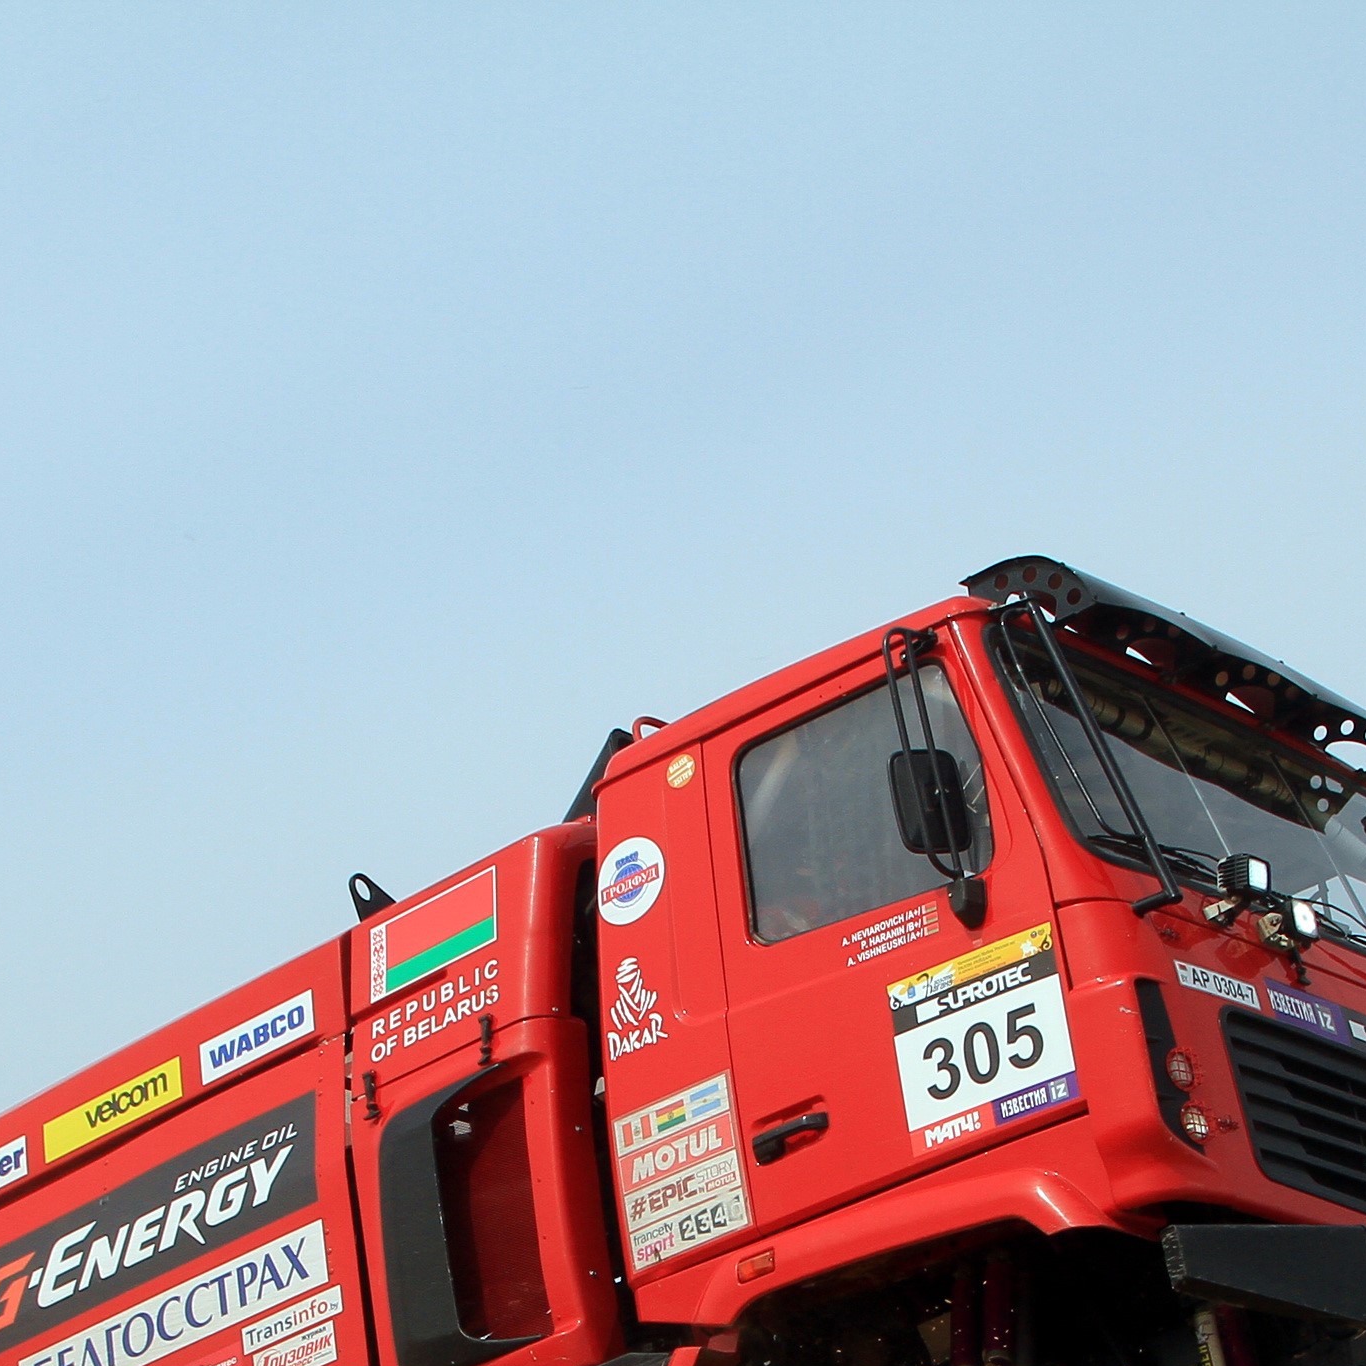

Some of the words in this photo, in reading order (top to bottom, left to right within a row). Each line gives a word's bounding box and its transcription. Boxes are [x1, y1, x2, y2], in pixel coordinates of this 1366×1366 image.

[602, 866, 658, 903] ГРОДФУД
[851, 914, 904, 943] NEVIAROVICH
[869, 925, 905, 947] HARANIN
[857, 937, 907, 962] VISHNEUSKI
[371, 959, 499, 1039] REPUBLIC
[936, 961, 1032, 1012] SUPROTEC
[1192, 968, 1210, 988] AP
[1213, 974, 1255, 1005] 0304-7
[370, 1038, 398, 1063] OF
[403, 985, 500, 1048] BELARUS
[1267, 987, 1317, 1025] ИЗВЕСТИЯ
[209, 1005, 305, 1069] WABCO
[607, 1013, 669, 1062] DAKAR
[922, 1004, 1045, 1101] 305
[85, 1071, 169, 1129] velcom
[1000, 1086, 1048, 1119] ИЗВЕСТИЯ
[924, 1110, 982, 1149] МАТЧ!
[173, 1140, 257, 1195] ENGINE
[262, 1122, 299, 1149] OIL
[631, 1124, 723, 1185] MOTUL
[695, 1157, 735, 1185] STORY
[706, 1173, 736, 1192] MOTUL
[633, 1221, 674, 1248] francetv
[636, 1232, 675, 1262] sport
[301, 1325, 327, 1342] журнал
